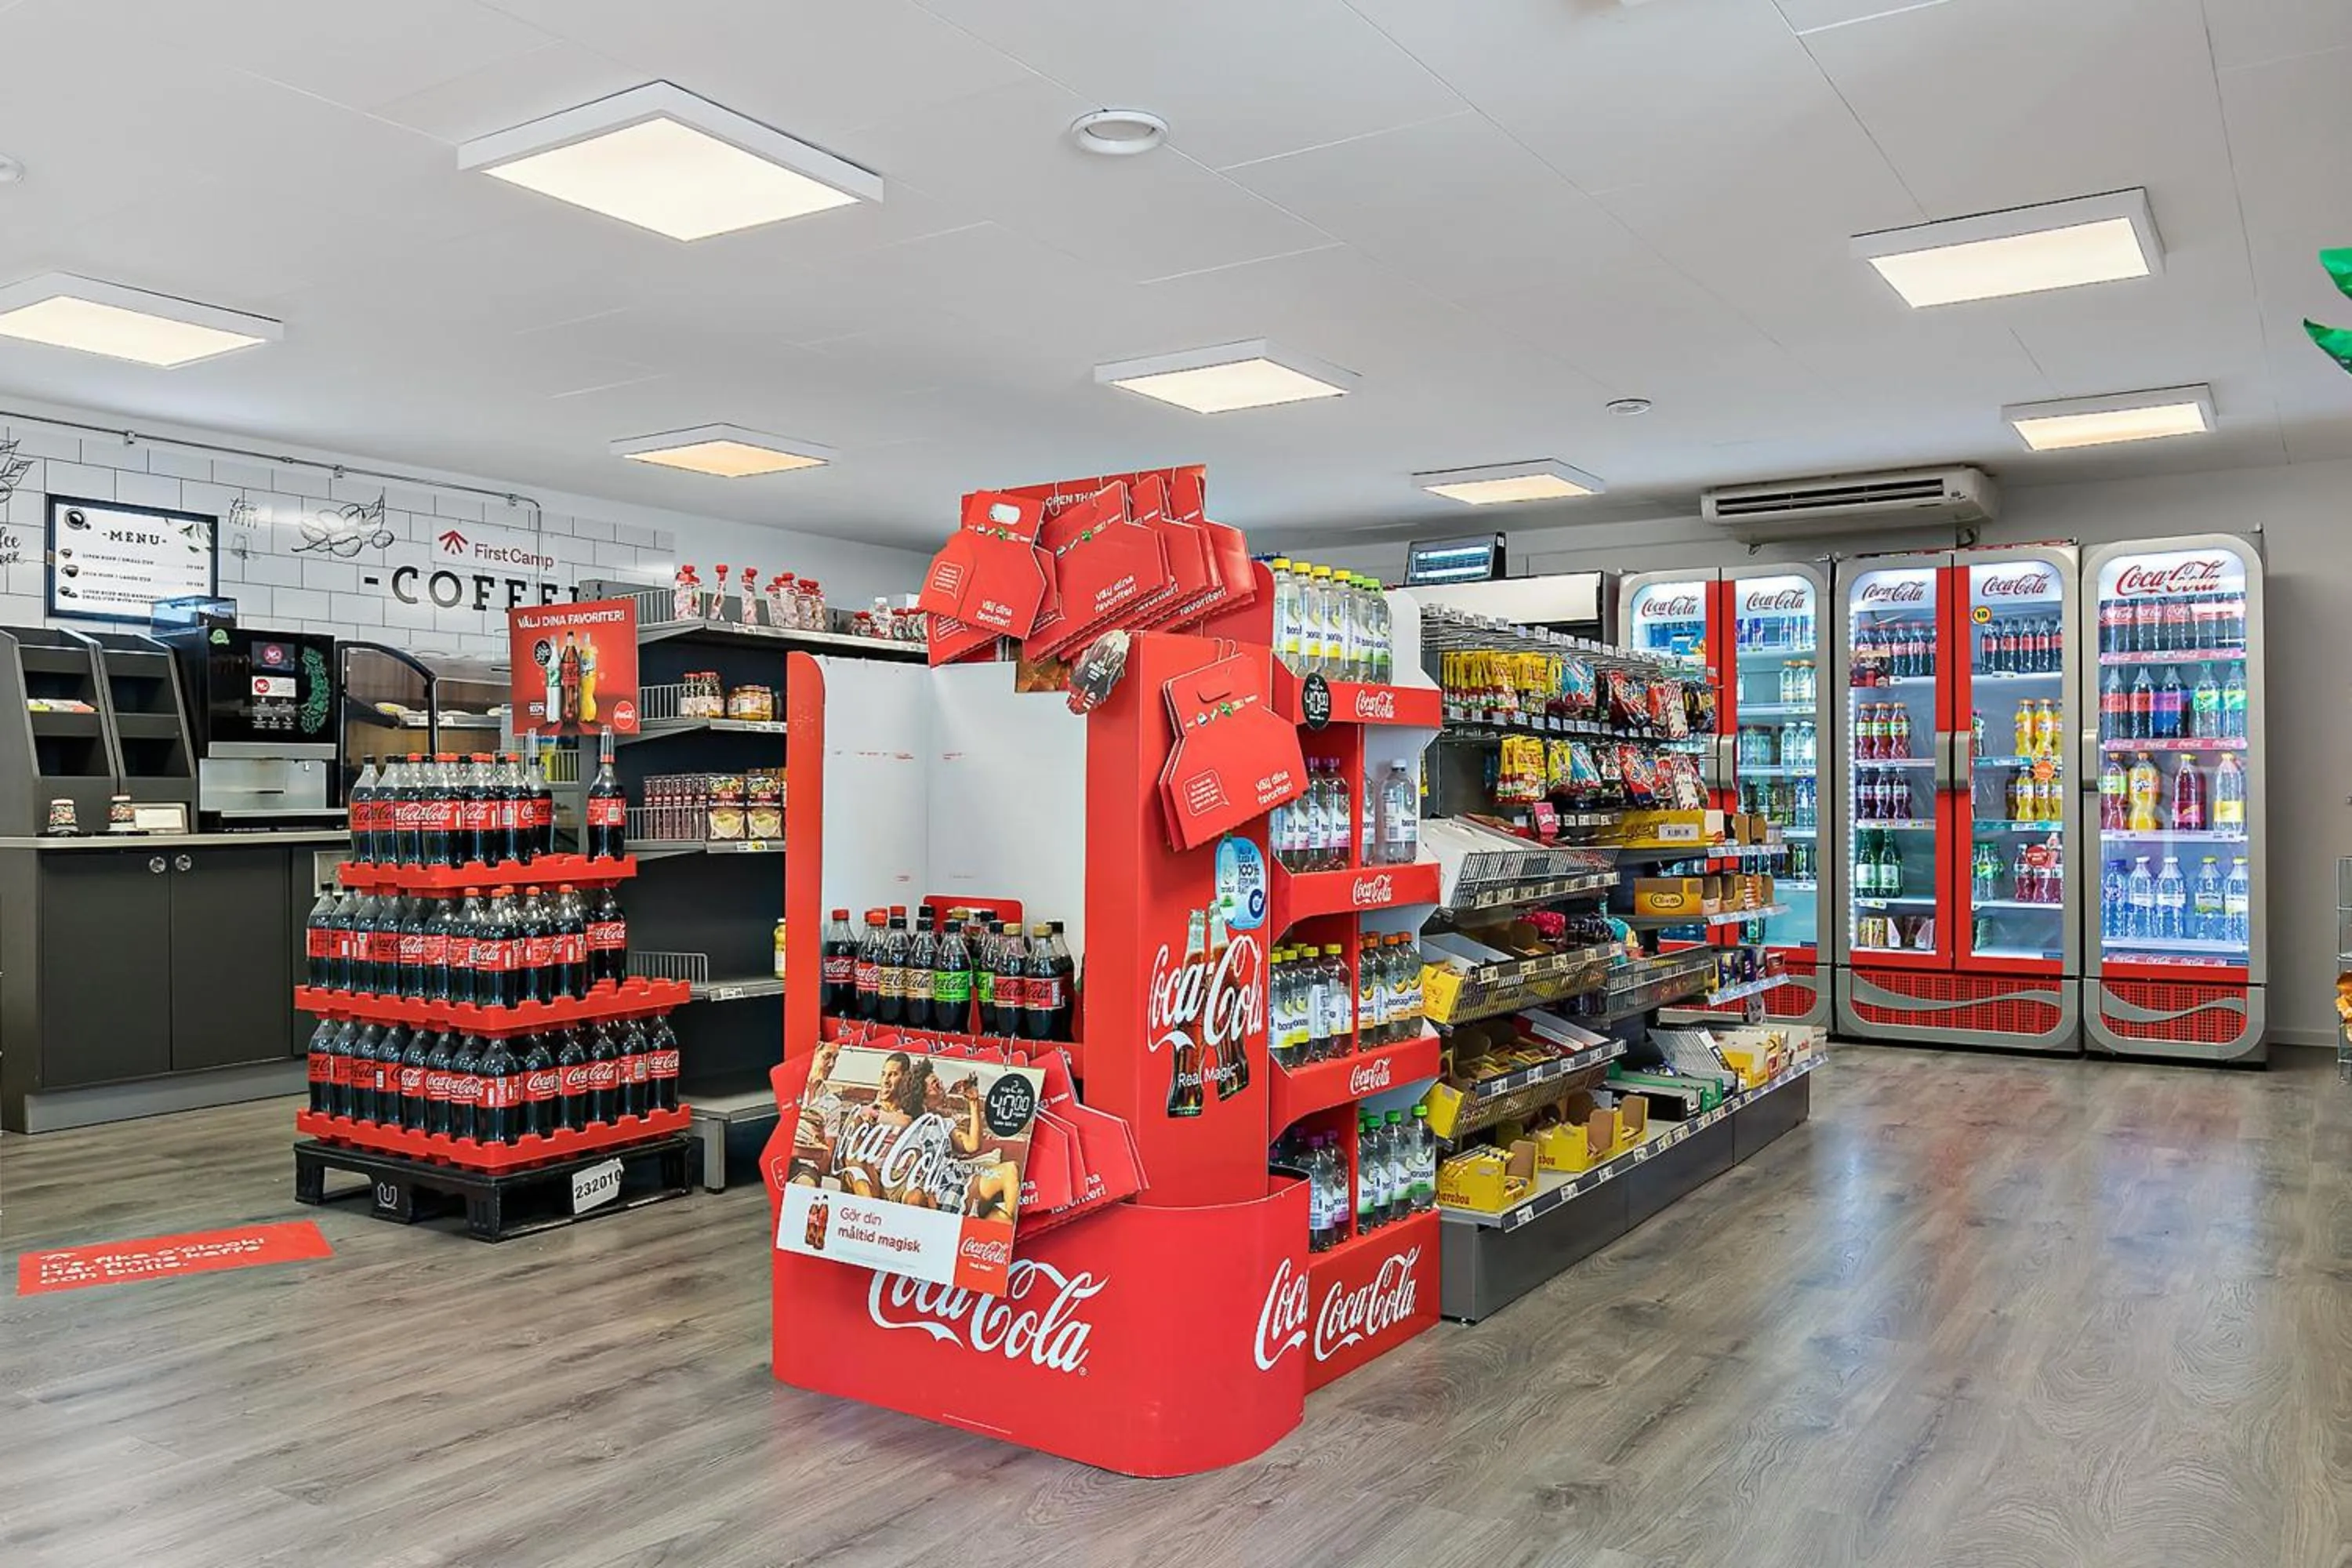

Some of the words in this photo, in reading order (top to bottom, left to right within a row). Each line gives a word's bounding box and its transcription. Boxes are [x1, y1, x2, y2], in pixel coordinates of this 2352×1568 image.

[474, 543, 508, 562] First
[510, 550, 554, 572] Camp
[1862, 581, 1926, 602] Coca-Cola
[1981, 574, 2052, 597] Coca-Cola
[2116, 560, 2226, 596] Coca-Cola
[1642, 596, 1697, 618] Coca-Cola
[1746, 590, 1806, 612] Coca-Cola
[517, 615, 540, 628] VÄLJ
[543, 615, 566, 626] DINA
[568, 609, 625, 625] FAVORITER!
[1356, 689, 1395, 719] Coca-Cola
[1352, 874, 1393, 906] Coca-Cola
[1148, 935, 1264, 1053] Coca-Cola
[1178, 1070, 1203, 1086] Real
[1203, 1064, 1236, 1084] Magic
[1350, 1058, 1392, 1096] Coca-Cola
[840, 1207, 861, 1221] Gör
[863, 1212, 882, 1226] din
[838, 1225, 876, 1243] måltid
[878, 1235, 921, 1253] magisk
[960, 1236, 1011, 1265] Coca-Cola
[867, 1258, 1110, 1374] CocaCola
[1313, 1243, 1422, 1363] Coca-Cola
